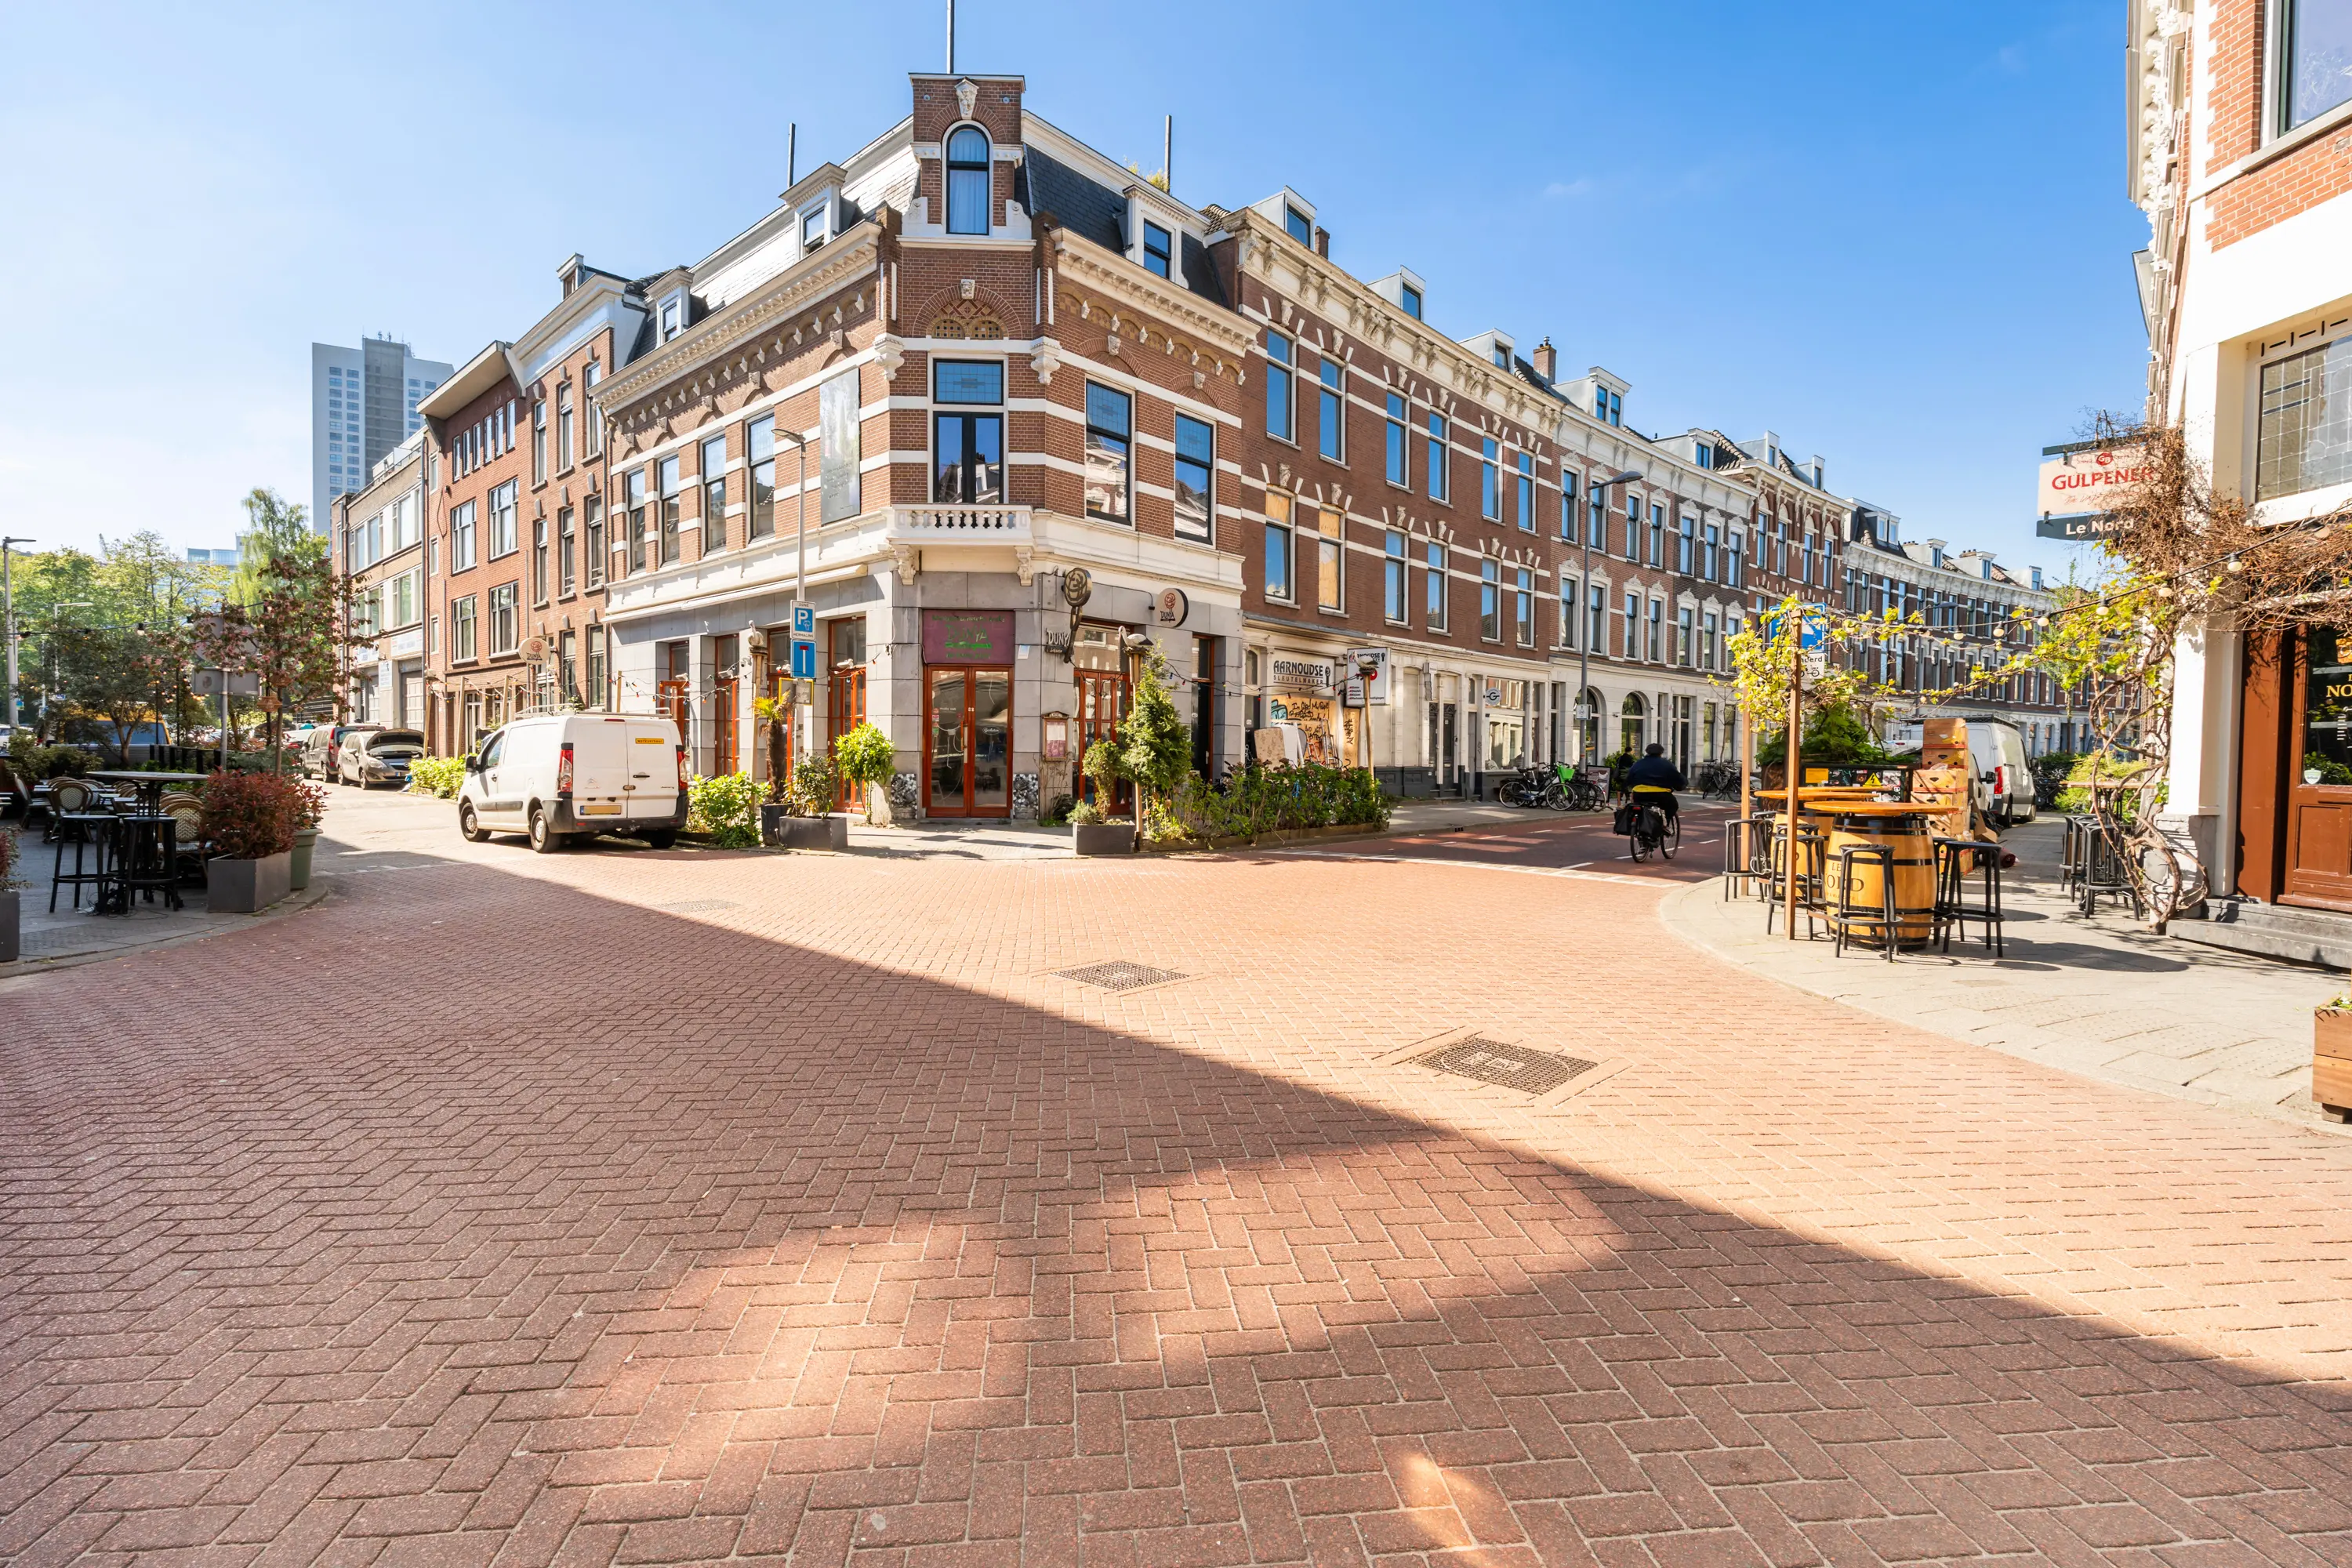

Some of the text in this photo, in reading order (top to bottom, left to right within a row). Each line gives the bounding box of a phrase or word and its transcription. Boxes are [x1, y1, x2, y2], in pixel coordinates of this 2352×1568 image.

[2052, 466, 2154, 490] GULPENER
[2066, 519, 2134, 535] Le Nord
[797, 610, 808, 625] P
[1273, 660, 1323, 677] AARNOUDSE
[1273, 675, 1323, 684] SLEUTELMAKER
